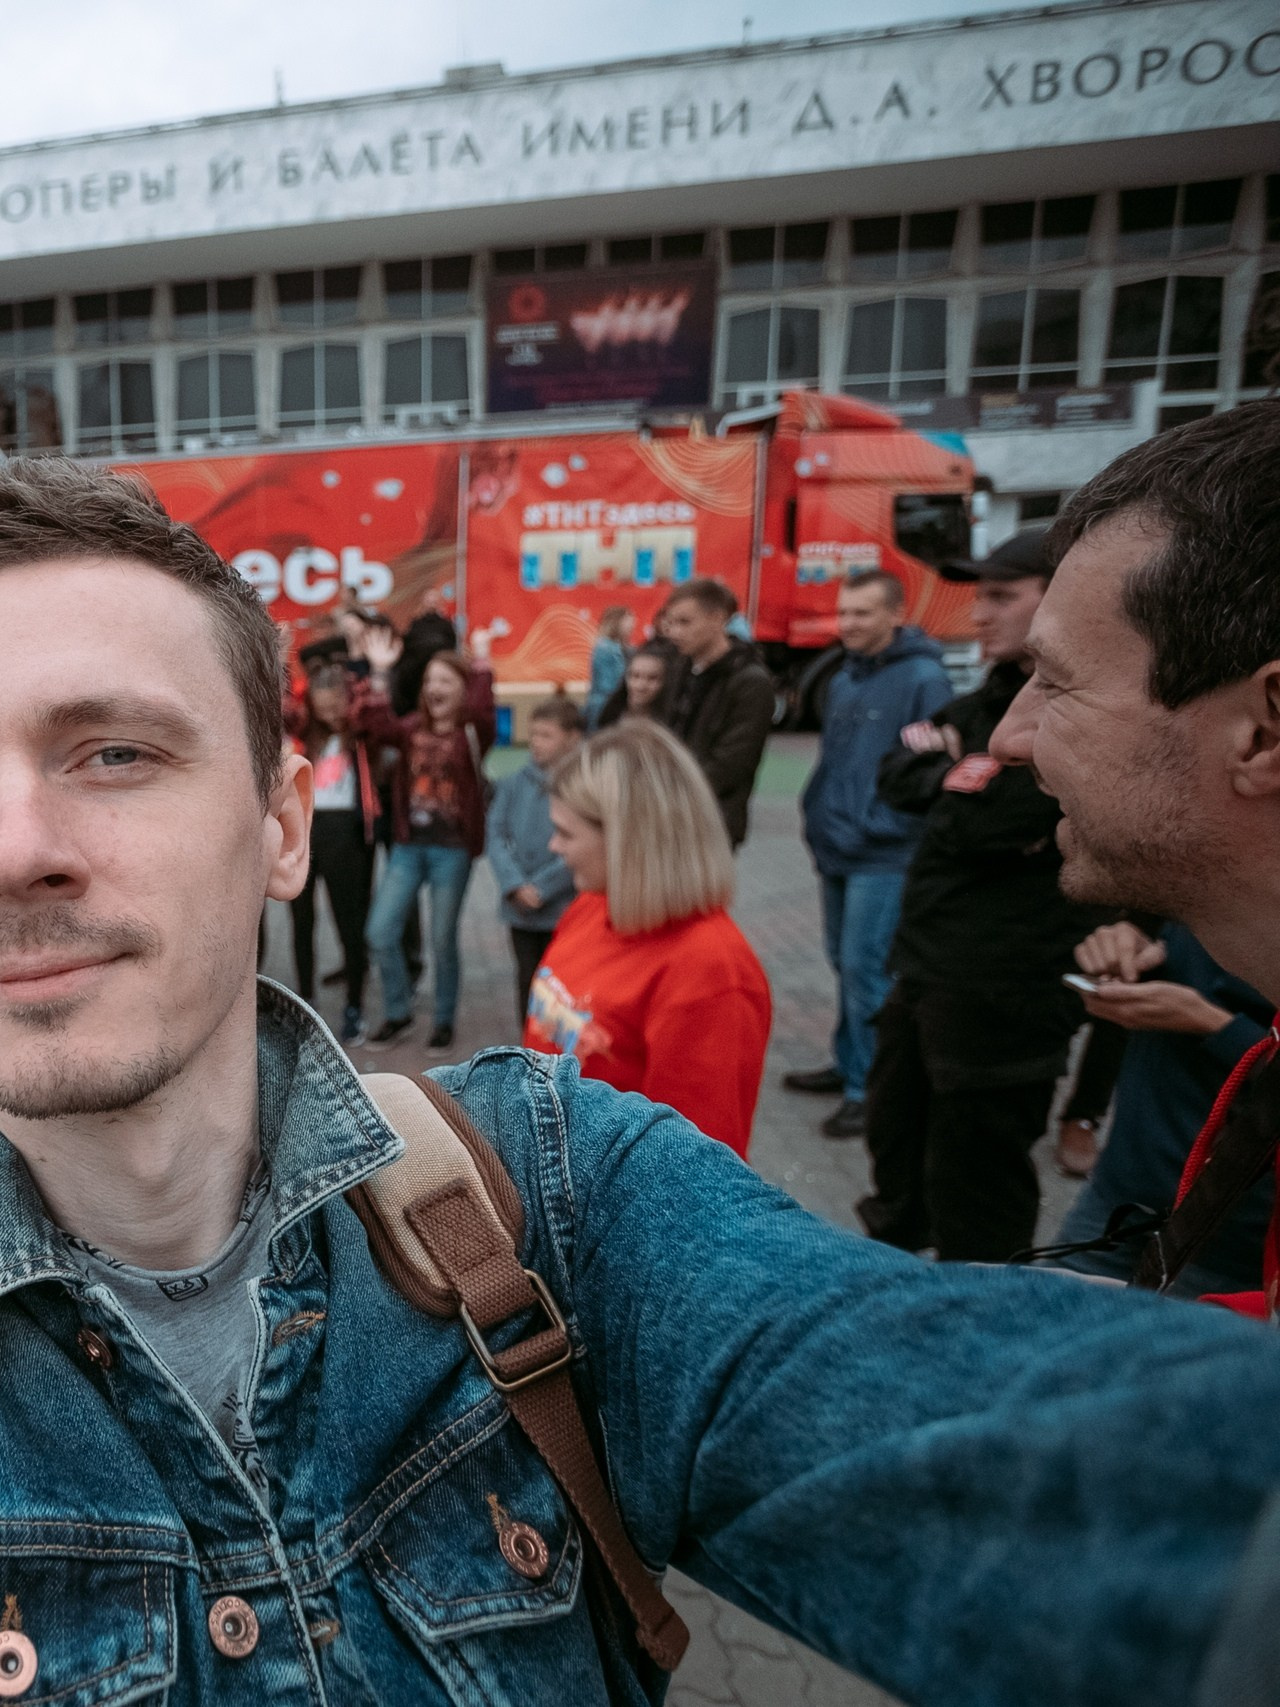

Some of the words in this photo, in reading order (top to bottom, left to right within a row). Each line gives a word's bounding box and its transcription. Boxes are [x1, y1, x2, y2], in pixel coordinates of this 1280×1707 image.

[207, 154, 244, 196] И
[276, 129, 485, 189] БАЛЕТА
[521, 97, 752, 159] ИМЕНИ
